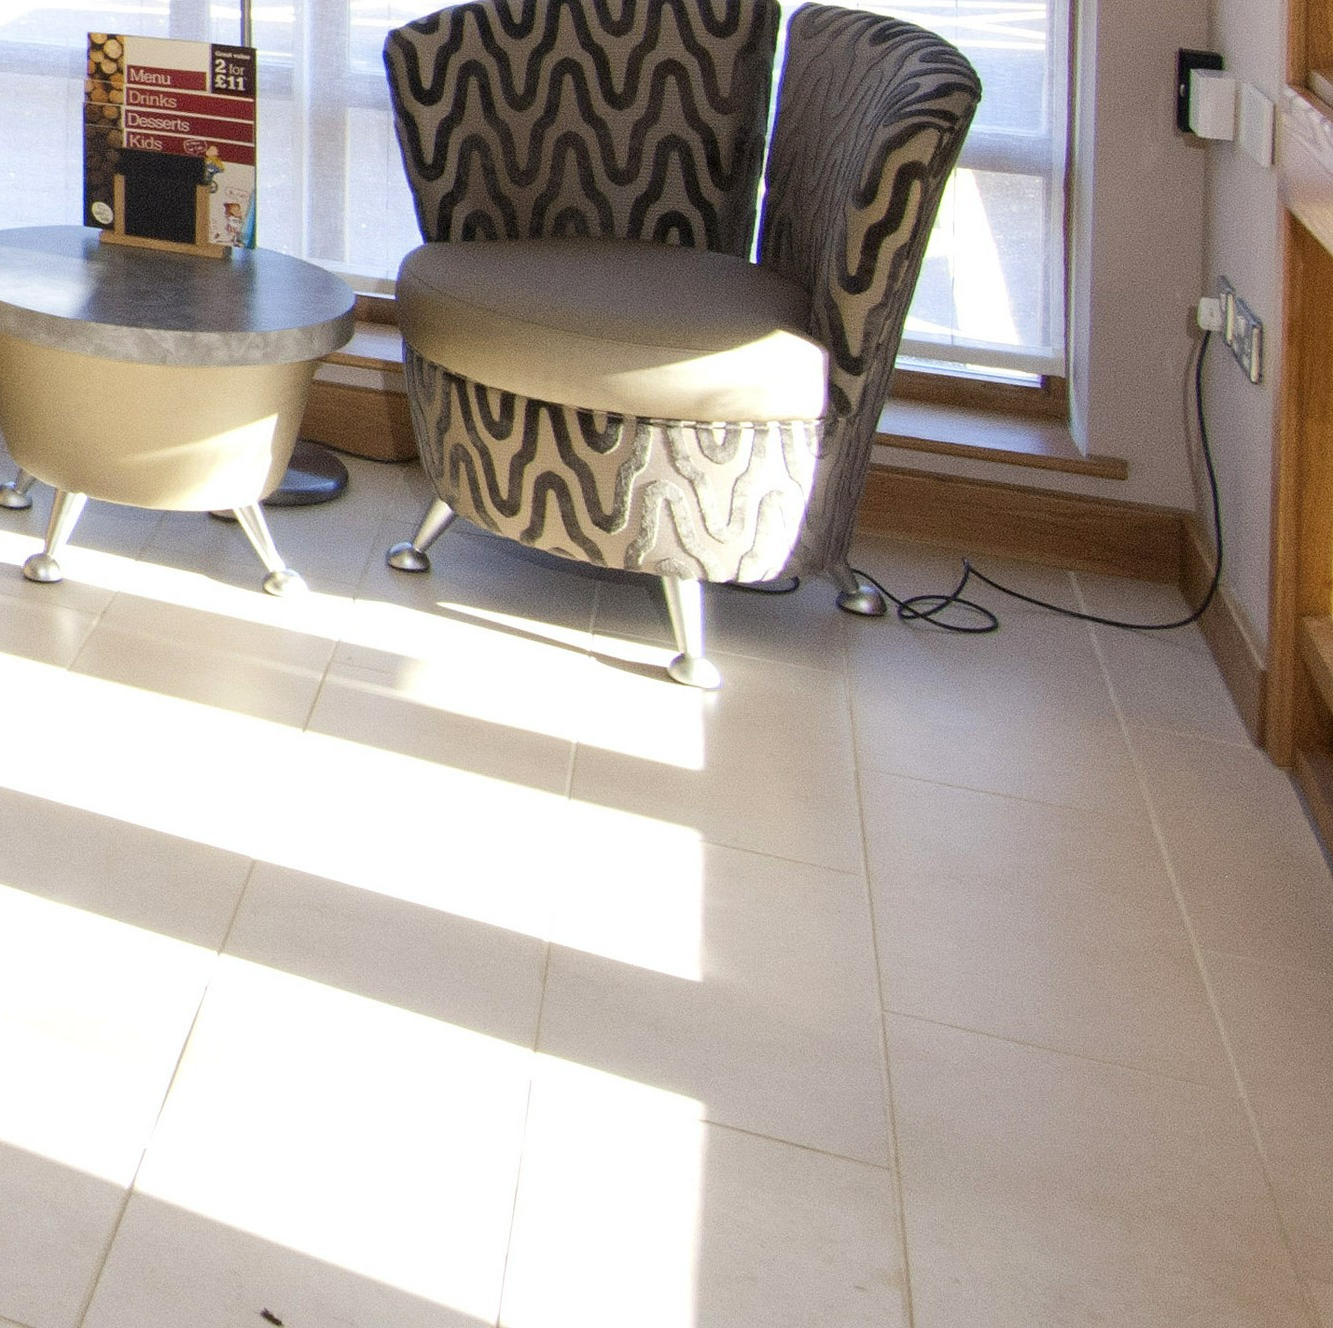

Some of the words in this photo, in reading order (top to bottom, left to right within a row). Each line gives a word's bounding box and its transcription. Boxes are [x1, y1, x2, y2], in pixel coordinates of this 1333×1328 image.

[215, 58, 227, 73] 2
[229, 63, 245, 75] for
[129, 68, 171, 85] Menu
[129, 91, 177, 108] Drinks
[127, 113, 190, 132] Desserts
[129, 134, 163, 150] Kids
